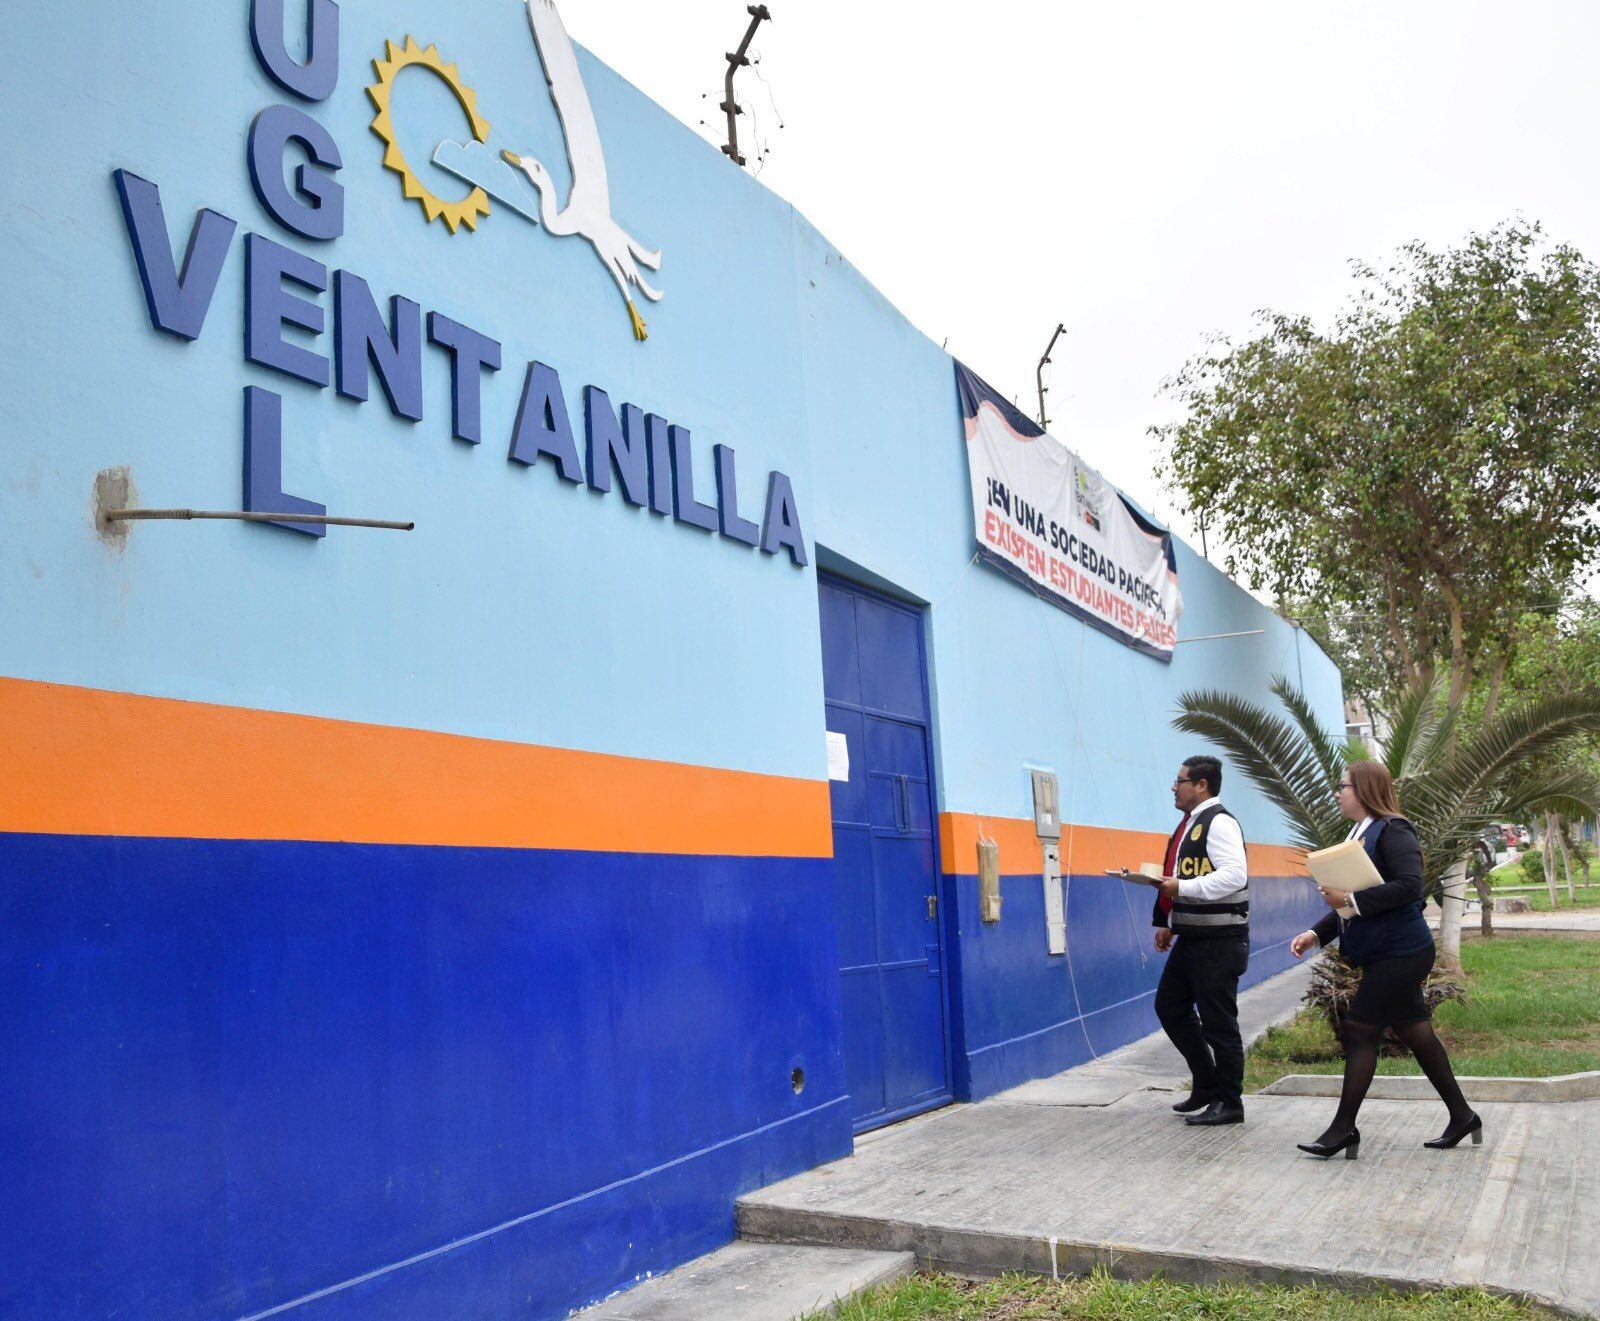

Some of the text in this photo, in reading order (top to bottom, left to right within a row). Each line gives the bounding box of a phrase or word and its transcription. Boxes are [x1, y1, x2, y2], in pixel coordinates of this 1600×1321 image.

[113, 168, 810, 567] VENTANILLA
[242, 0, 345, 539] UGEL
[984, 508, 1046, 578] EXISTEN
[1050, 555, 1134, 630] ESTUDIANTES
[1014, 494, 1047, 541] UNA
[1050, 520, 1116, 585] SOCIEDAD
